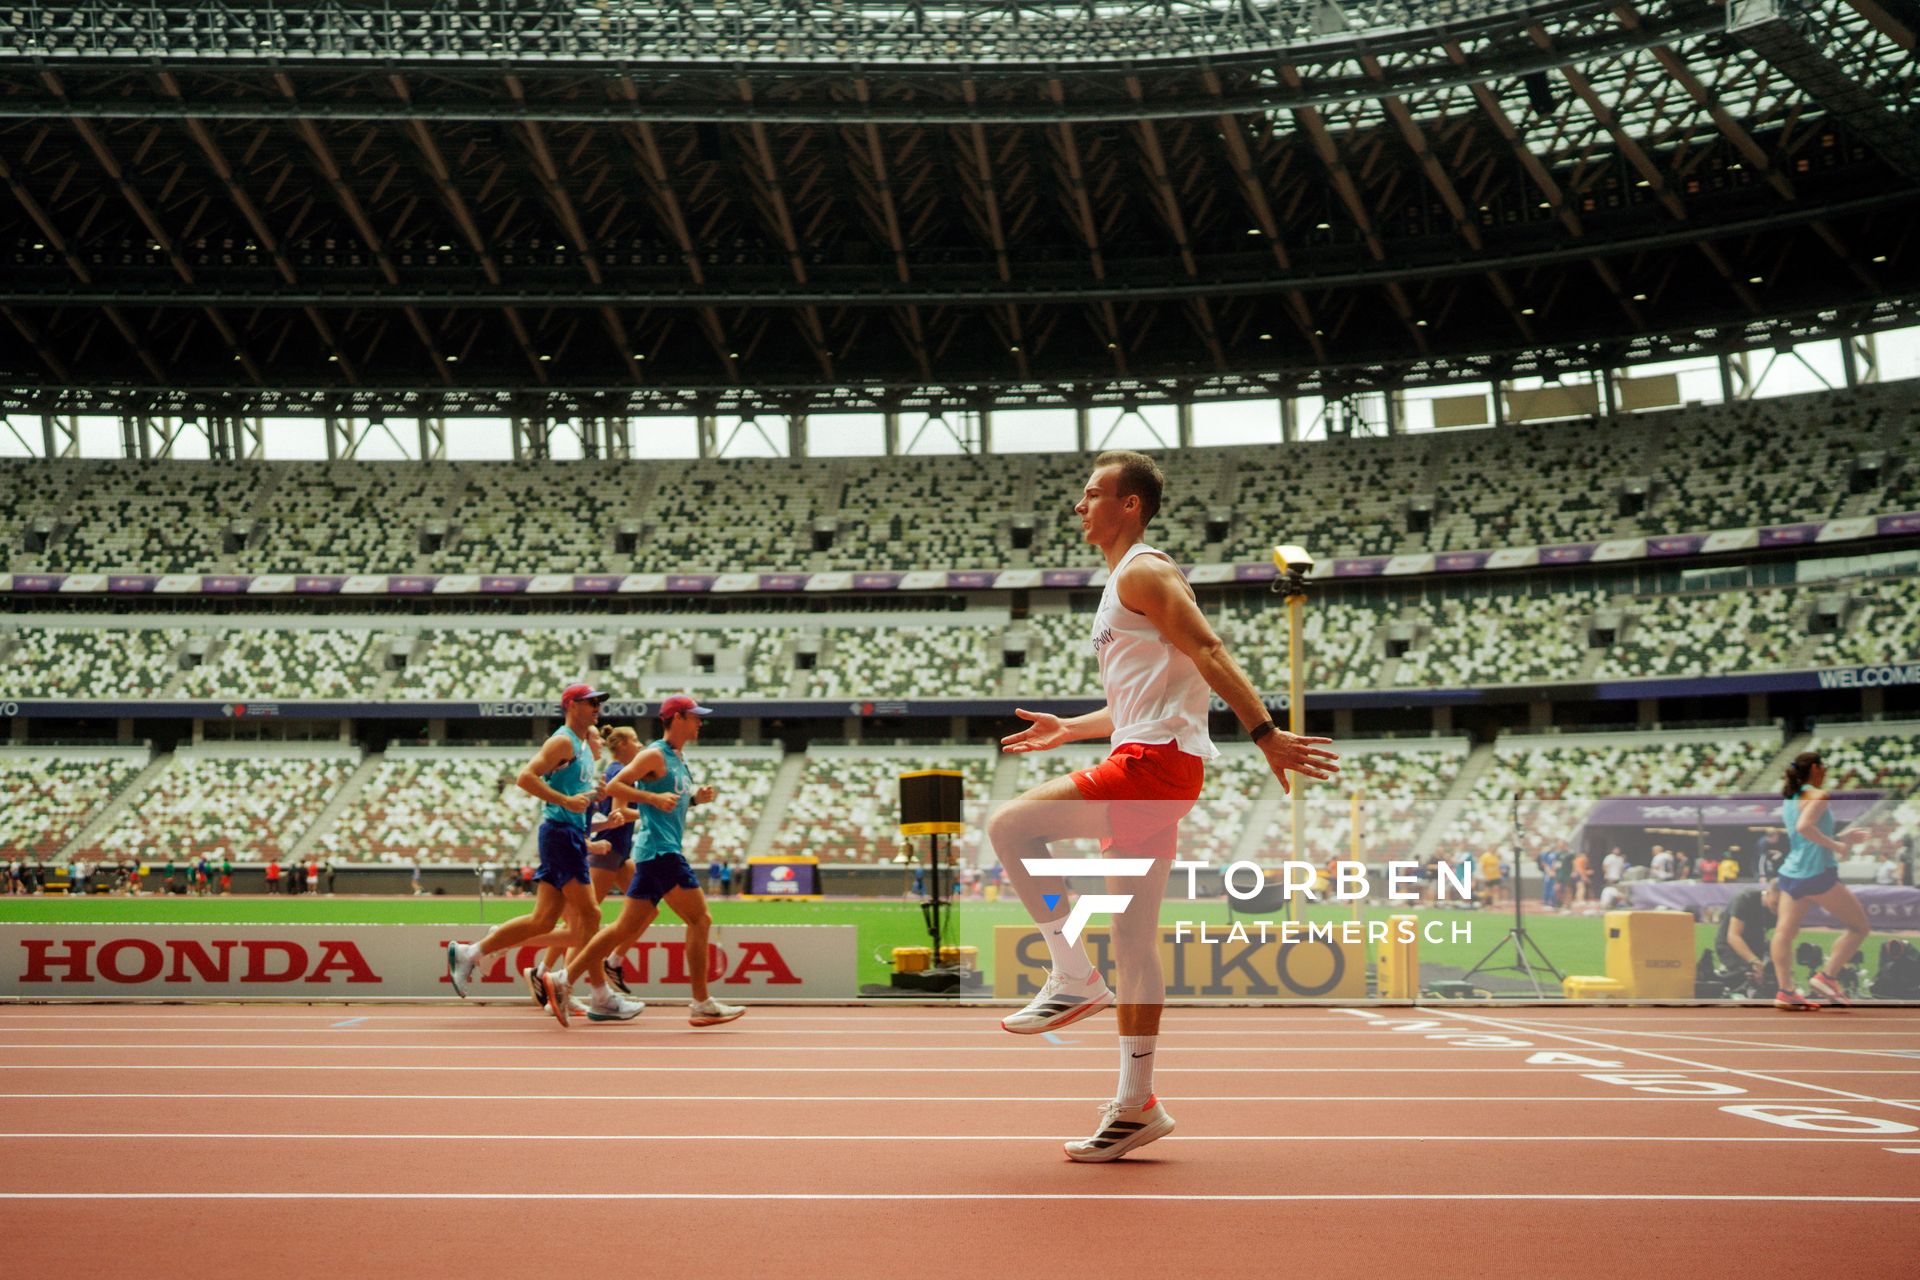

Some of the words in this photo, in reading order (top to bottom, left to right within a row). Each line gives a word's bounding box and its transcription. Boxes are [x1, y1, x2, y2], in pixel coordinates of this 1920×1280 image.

[478, 702, 562, 717] WELCOME
[598, 702, 648, 717] OKYO
[19, 939, 383, 984] HONDA
[1424, 1034, 1535, 1047] 3
[1524, 1051, 1625, 1068] 4
[1580, 1074, 1749, 1095] 5
[1718, 1105, 1919, 1134] 6
